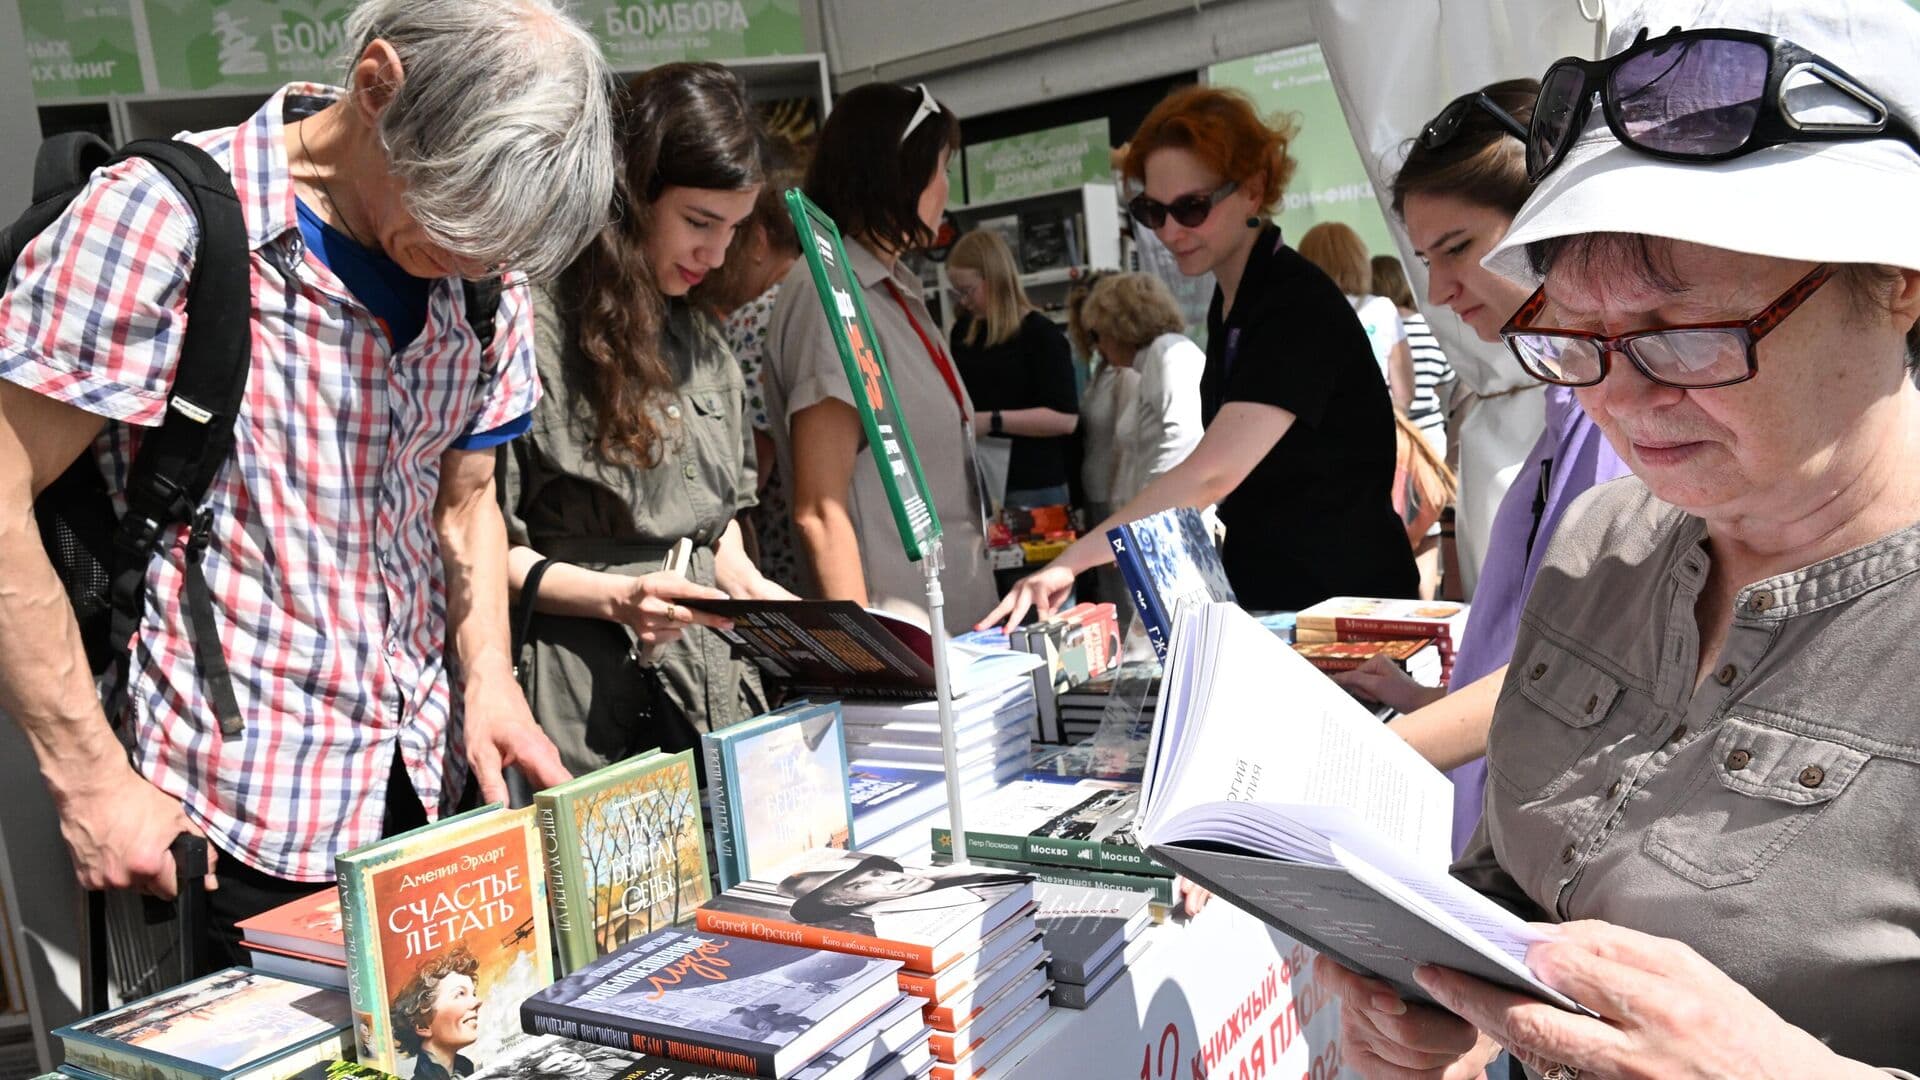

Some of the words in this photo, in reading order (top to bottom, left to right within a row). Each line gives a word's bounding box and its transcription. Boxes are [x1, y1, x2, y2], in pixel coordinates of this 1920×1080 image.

[606, 1, 749, 36] БОМБОРА
[271, 20, 344, 54] БОМ
[59, 60, 117, 80] КНИГ
[1149, 626, 1168, 661] ГЖ
[1226, 757, 1248, 802] ОГИЙ
[1243, 763, 1262, 801] ЛИЯ
[627, 813, 653, 846] НА
[610, 835, 678, 886] БЕРЕГАХ
[1030, 844, 1069, 857] Москва
[1101, 850, 1140, 864] Москва
[400, 863, 459, 893] Амелия
[460, 846, 507, 872] Эрхарт
[1095, 881, 1134, 892] Москва
[388, 866, 523, 934] СЧАСТЬЕ
[405, 899, 515, 960] ЛЕТАТЬ
[707, 915, 748, 934] Сергей
[751, 922, 805, 943] Юрский
[822, 935, 840, 947] Кого
[841, 938, 868, 952] люблю,
[869, 946, 885, 954] того
[886, 949, 905, 959] здесь
[906, 953, 920, 961] нет
[577, 935, 716, 1001] МОБИЛИЗОВАННЫЕ
[910, 983, 923, 992] нет
[1191, 962, 1277, 1080] КНИЖНЫЙ
[1281, 943, 1310, 986] ФЕС
[632, 1033, 663, 1057] МУЗЫ
[1229, 1034, 1266, 1080] АЯ
[1302, 1040, 1345, 1080] 02
[641, 1067, 671, 1080] ИЯ
